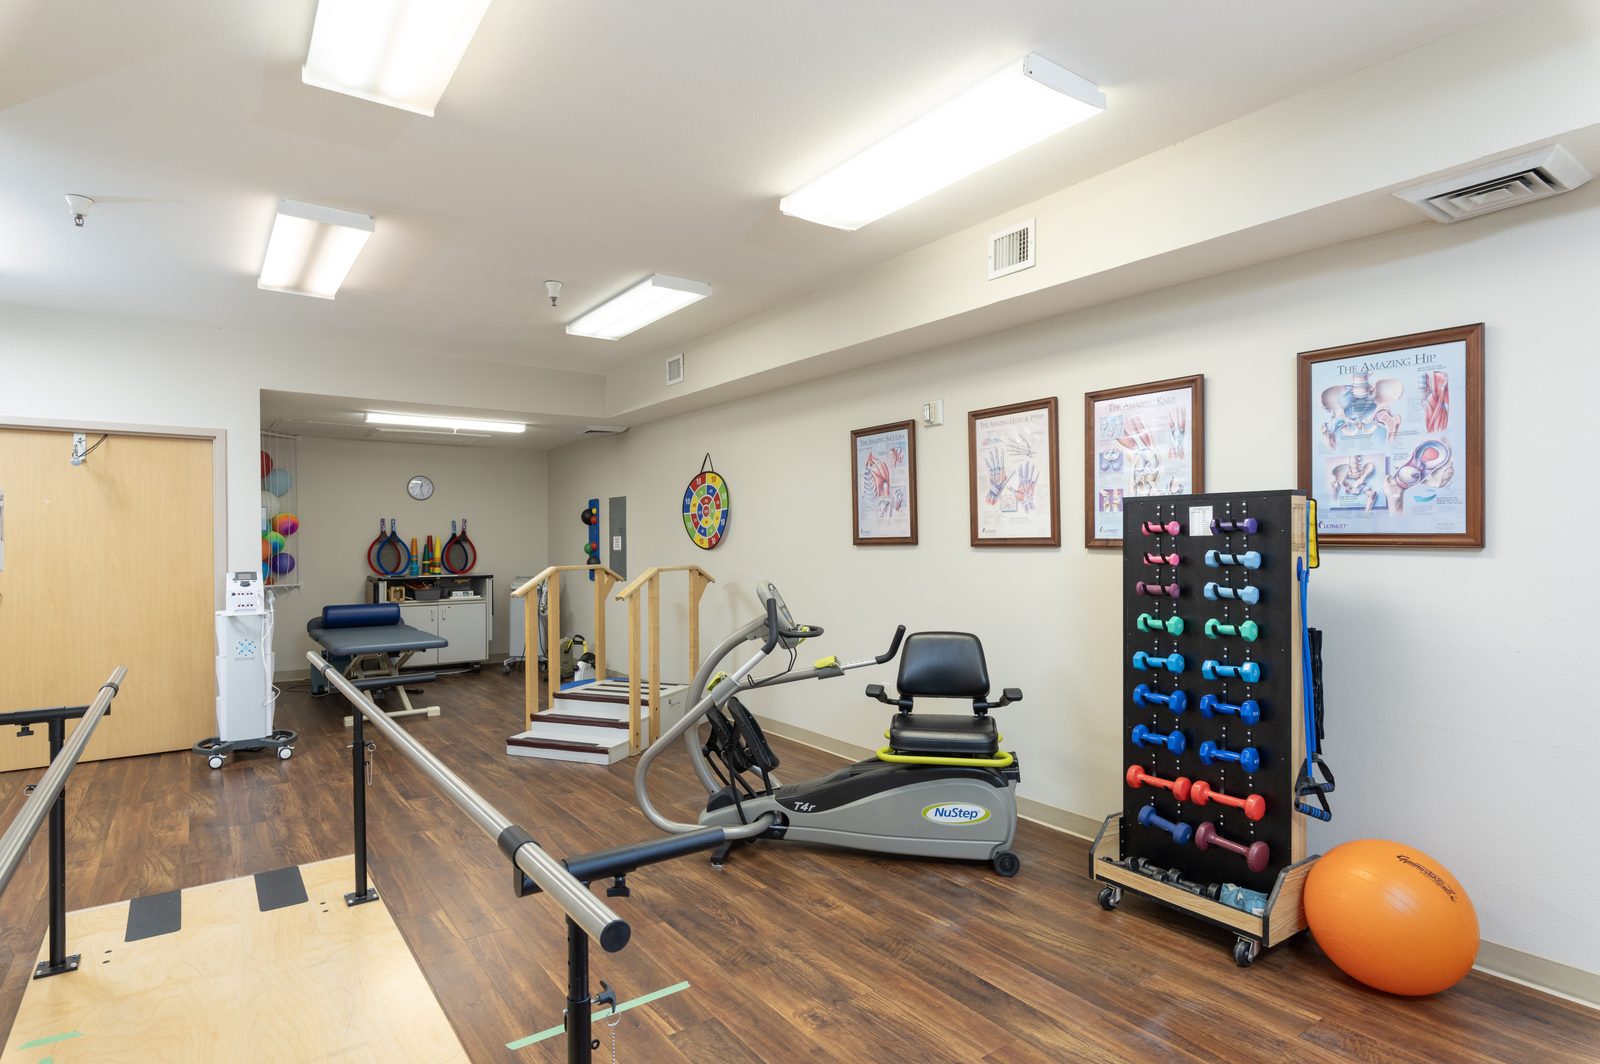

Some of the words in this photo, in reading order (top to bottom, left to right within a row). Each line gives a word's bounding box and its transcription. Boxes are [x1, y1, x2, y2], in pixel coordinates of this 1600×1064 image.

[1336, 364, 1358, 375] THE
[1360, 358, 1411, 372] AMAZING
[1414, 353, 1437, 364] HIP
[1107, 403, 1121, 412] THE
[1156, 396, 1177, 405] KNEE
[793, 801, 816, 812] T4r
[934, 808, 978, 820] NuStep
